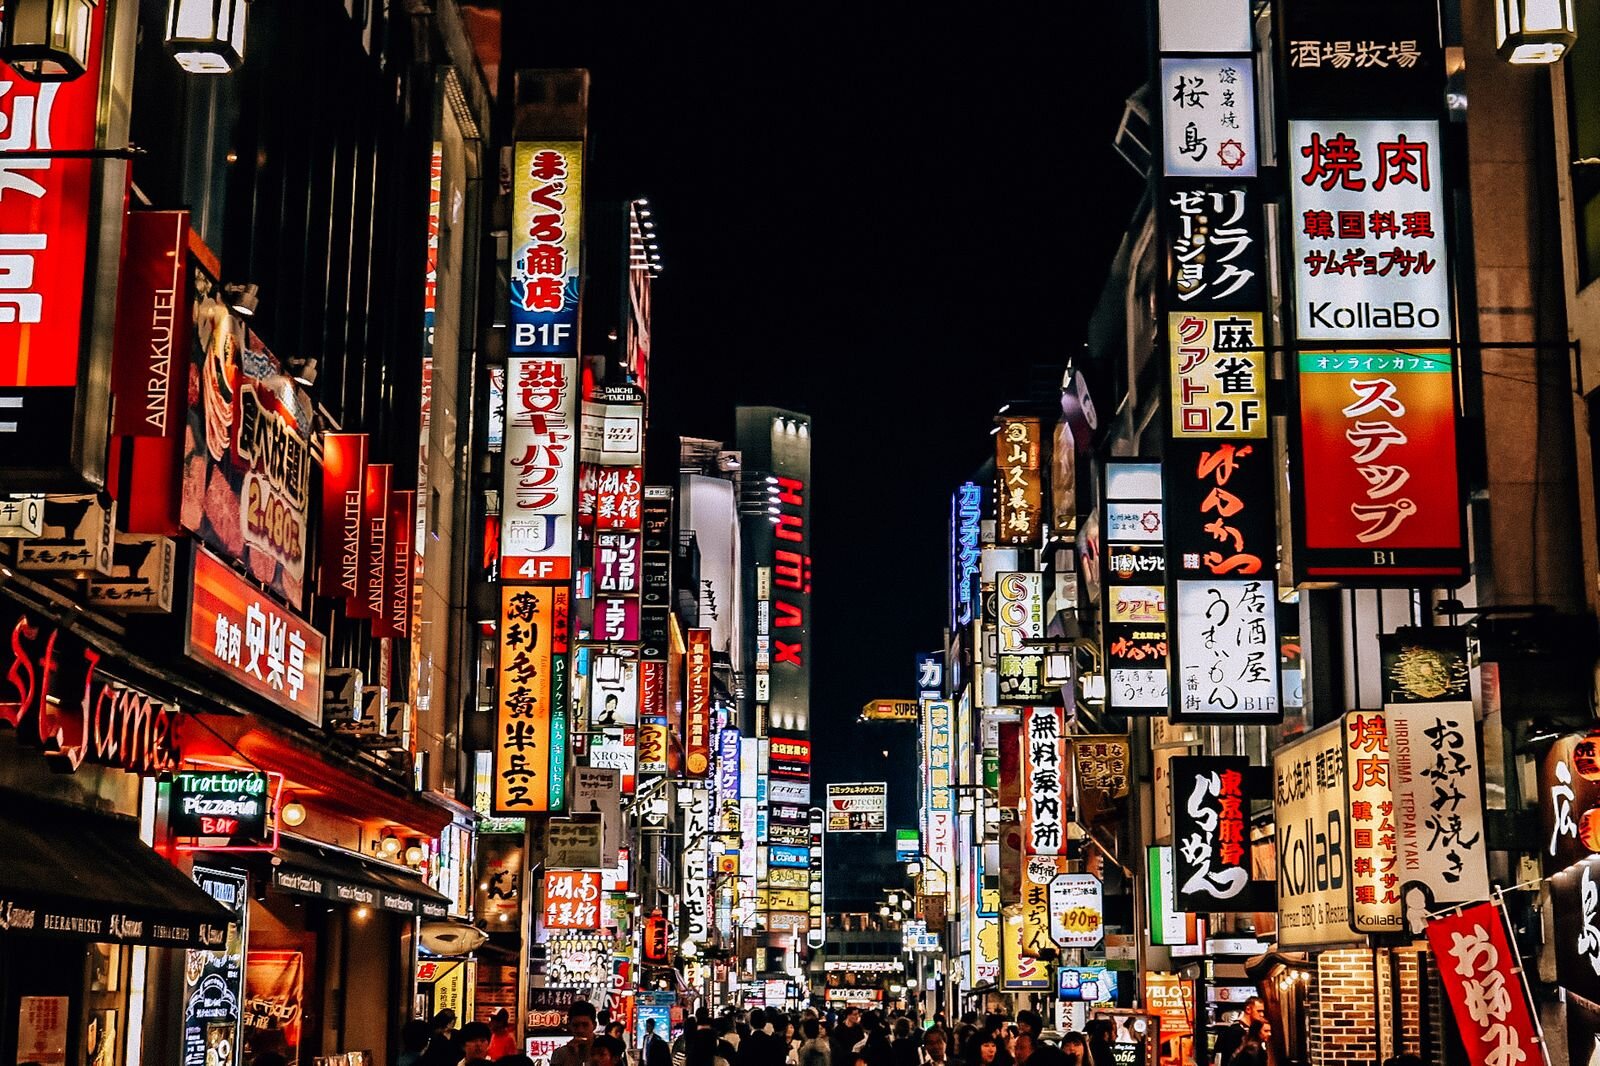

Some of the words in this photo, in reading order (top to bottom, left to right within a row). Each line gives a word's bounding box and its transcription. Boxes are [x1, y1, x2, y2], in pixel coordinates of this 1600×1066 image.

[1290, 40, 1421, 69] 酒場牧場
[1173, 76, 1209, 162] 桜島
[1301, 132, 1430, 192] 焼肉
[525, 149, 567, 311] まぐろ商店
[1304, 210, 1435, 240] 韓国料理
[1208, 190, 1255, 299] リラク
[1304, 247, 1436, 277] サムギョプサル
[1309, 302, 1440, 329] KollaBo
[515, 324, 571, 345] B1F
[145, 289, 175, 436] ANRAKUTEI
[1178, 315, 1211, 432] クアトロ
[1212, 316, 1255, 395] 麻雀
[1317, 357, 1435, 370] オンラインカフェ
[1215, 400, 1258, 432] 2F
[1342, 378, 1417, 543] ステップ
[599, 471, 640, 495] 湖南
[599, 496, 640, 519] 菜館
[342, 490, 360, 597] ANRAKUTEI
[1373, 551, 1396, 565] B1
[369, 517, 384, 618] ANRAKUTEI
[518, 559, 553, 578] 4F
[601, 549, 616, 590] ルーム
[393, 542, 409, 638] ANRAKUTEI
[605, 600, 625, 641] エデン
[1236, 582, 1270, 683] 居酒屋
[1000, 655, 1041, 677] 麻雀
[1185, 665, 1202, 711] 一番街
[1244, 695, 1275, 711] B1F
[722, 731, 738, 788] カラオケ
[771, 743, 808, 756] 全店営業中
[1349, 714, 1393, 792] 焼肉
[1394, 719, 1412, 784] HIROSHIMA
[182, 773, 264, 794] Trattoria
[1032, 714, 1059, 848] 無料案内所
[1420, 717, 1480, 883] お好み焼き
[202, 817, 239, 834] Bar
[1028, 863, 1056, 877] 新宿
[1352, 801, 1377, 905] 韓国料理
[548, 875, 598, 902] 湖南
[771, 896, 793, 906] ゲーム
[1028, 886, 1051, 951] まっちゃん
[1063, 911, 1098, 926] 190円
[528, 1011, 560, 1028] 19:00
[1113, 1051, 1135, 1062] oble
